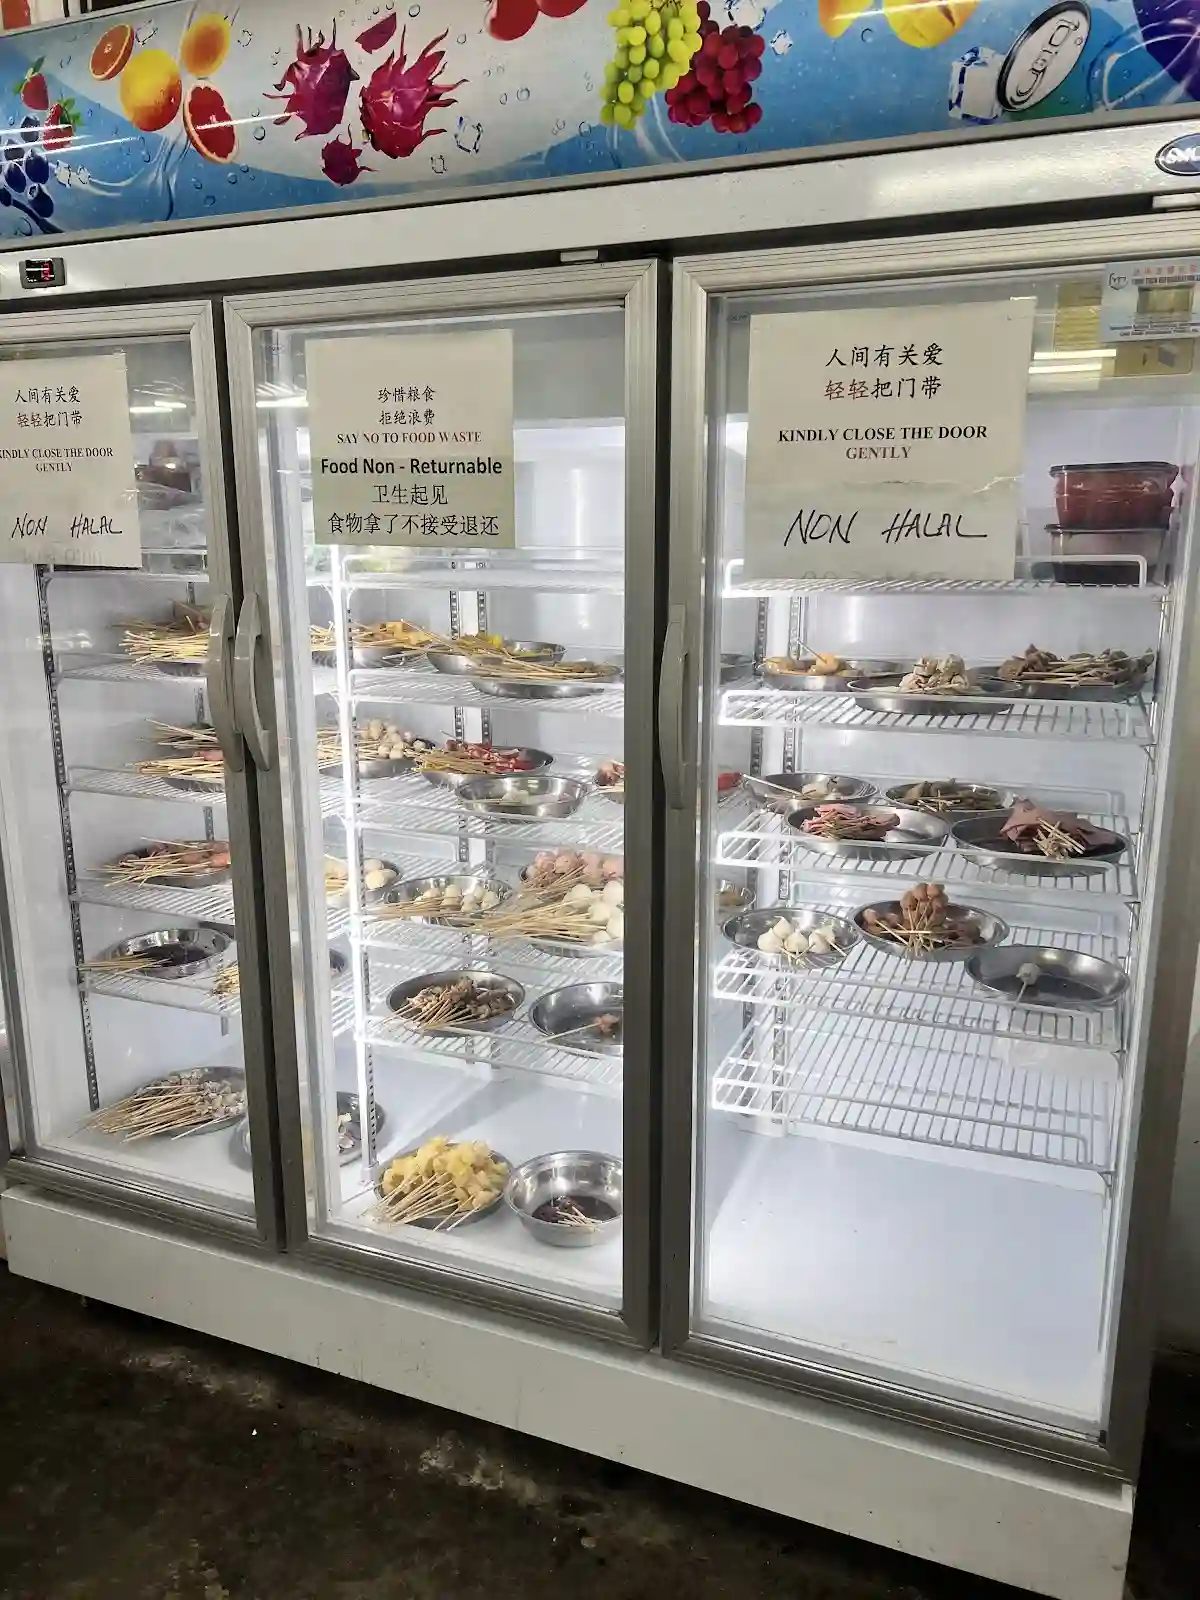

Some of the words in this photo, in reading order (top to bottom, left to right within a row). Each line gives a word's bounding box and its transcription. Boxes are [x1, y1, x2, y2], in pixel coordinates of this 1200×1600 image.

[825, 343, 944, 368] 人间有关爱
[15, 386, 80, 404] 人间有关爱
[378, 384, 435, 403] 珍惜粮食
[824, 376, 941, 400] 轻轻把门带
[17, 408, 82, 428] 轻轻把门带
[379, 409, 435, 426] 拒绝浪费
[338, 434, 358, 444] SAY
[364, 433, 379, 444] NO
[382, 433, 398, 443] TO
[401, 432, 435, 443] FOOD
[439, 432, 481, 442] WASTE
[778, 429, 838, 442] KINDLY
[843, 428, 895, 440] CLOSE
[900, 427, 933, 440] THE
[938, 424, 987, 438] DOOR
[0, 449, 29, 460] INDLY
[32, 449, 62, 459] CLOSE
[63, 448, 84, 457] THE
[86, 448, 113, 457] DOOR
[846, 447, 911, 459] GENTLY
[36, 462, 72, 472] GENTLY
[322, 458, 358, 474] Food
[363, 459, 394, 474] Non
[411, 457, 502, 475] Returnable
[372, 484, 448, 505] 卫生起见
[11, 513, 48, 539] NON
[70, 513, 122, 540] HALAL
[328, 512, 499, 536] 食物拿了不接受退还
[784, 509, 858, 546] NON
[881, 508, 988, 544] HALAL
